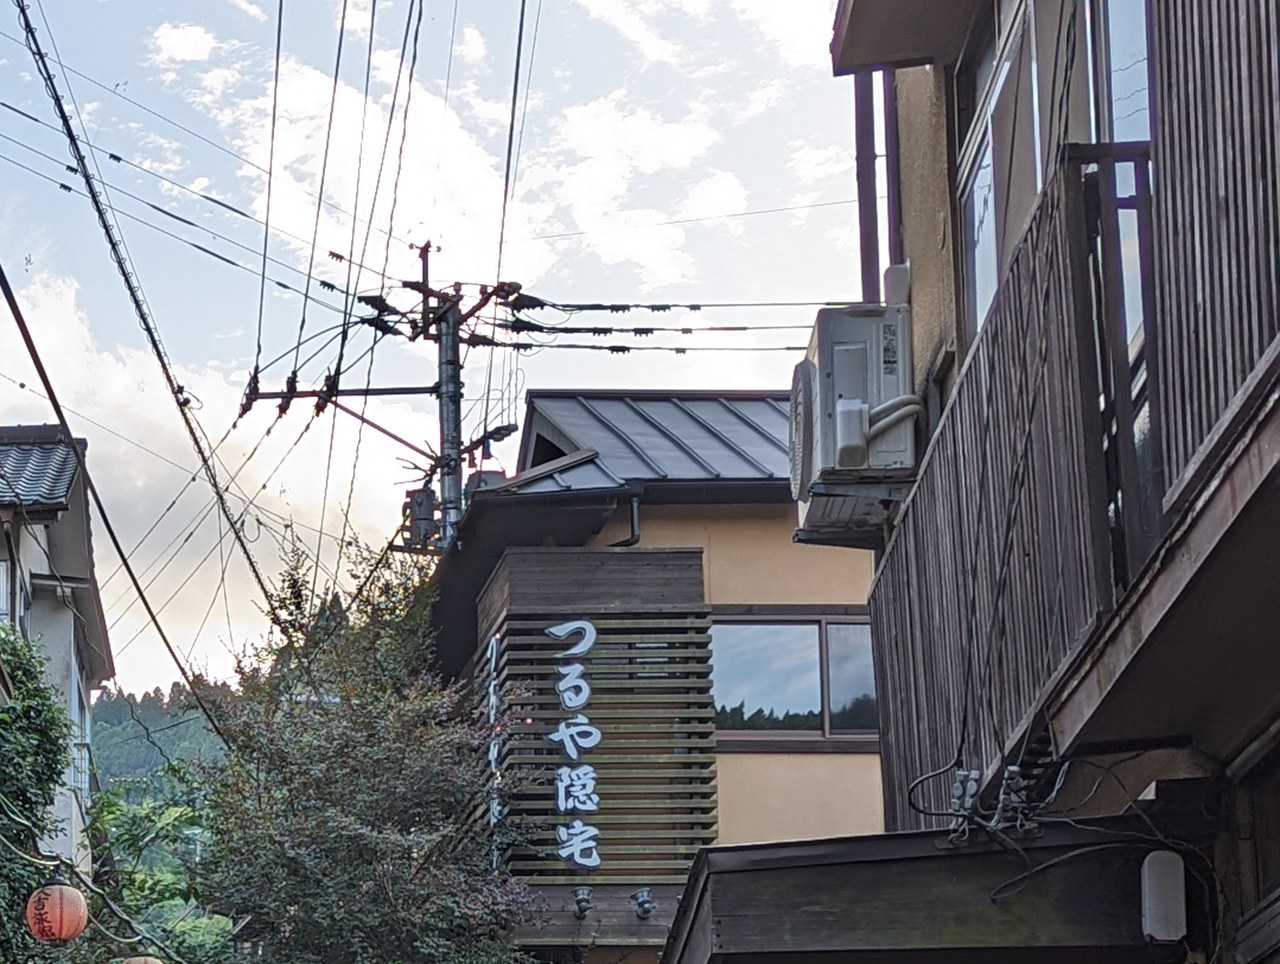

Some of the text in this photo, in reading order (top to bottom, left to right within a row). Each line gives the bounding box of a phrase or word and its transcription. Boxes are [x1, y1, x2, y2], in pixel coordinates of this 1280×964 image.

[545, 620, 602, 869] つるや隠宅
